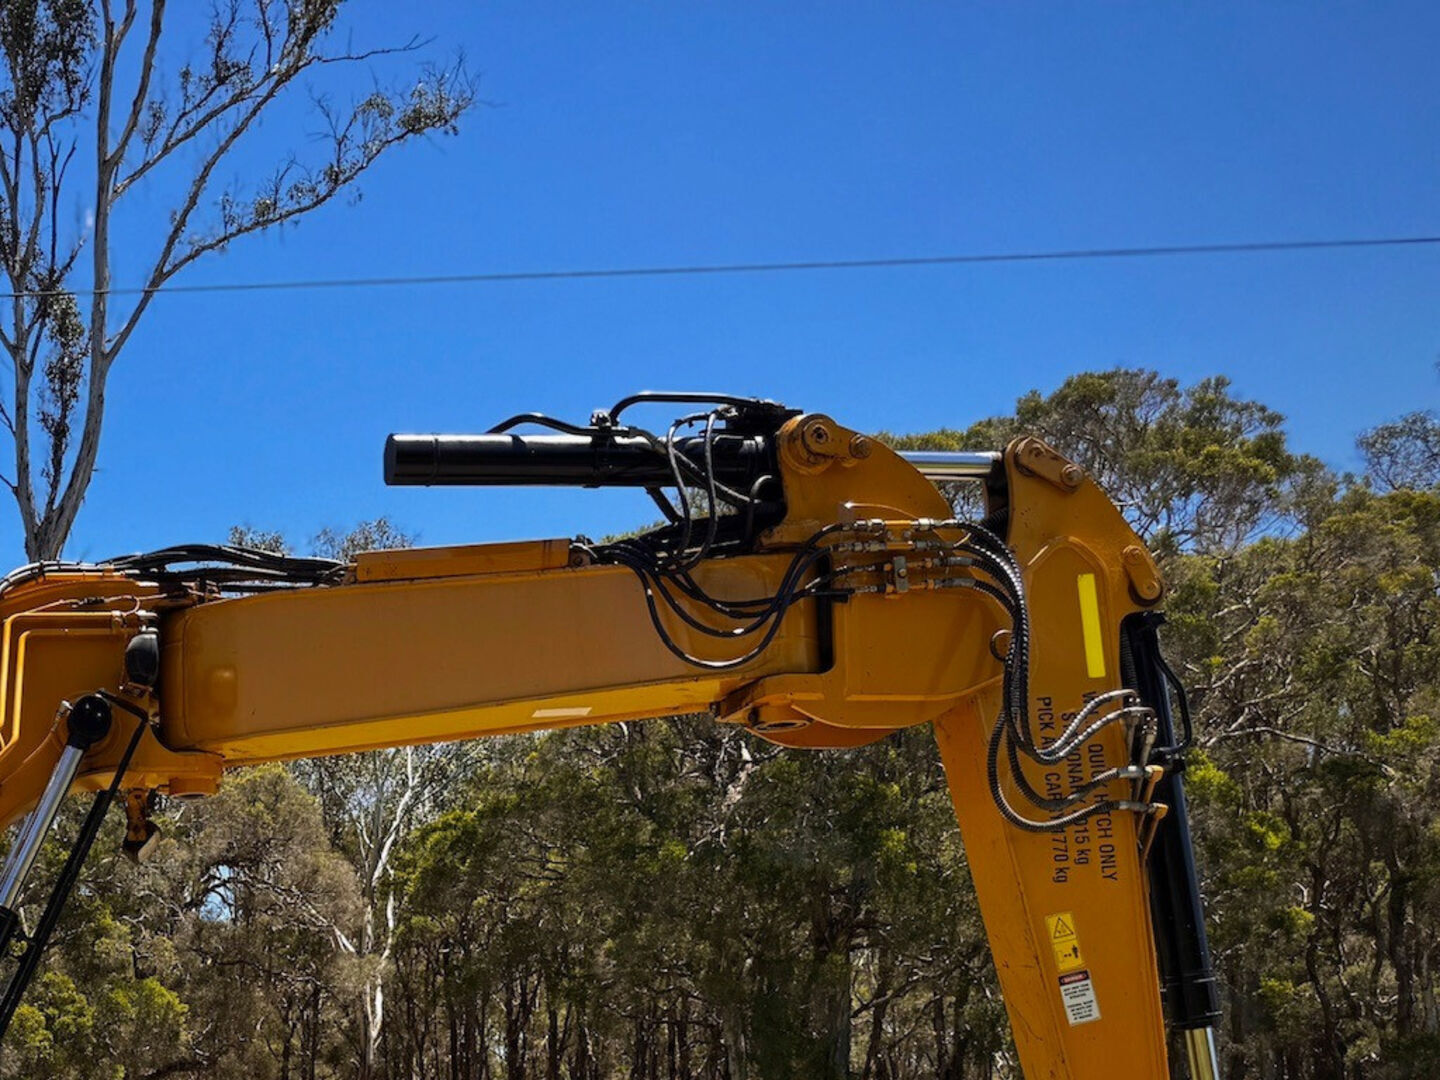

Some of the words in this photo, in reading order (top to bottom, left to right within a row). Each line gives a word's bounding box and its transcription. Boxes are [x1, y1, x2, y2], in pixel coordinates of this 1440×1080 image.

[1036, 696, 1055, 731] PICK
[1052, 867, 1070, 884] kg
[1074, 848, 1091, 865] kg
[1098, 844, 1118, 881] ONLY
